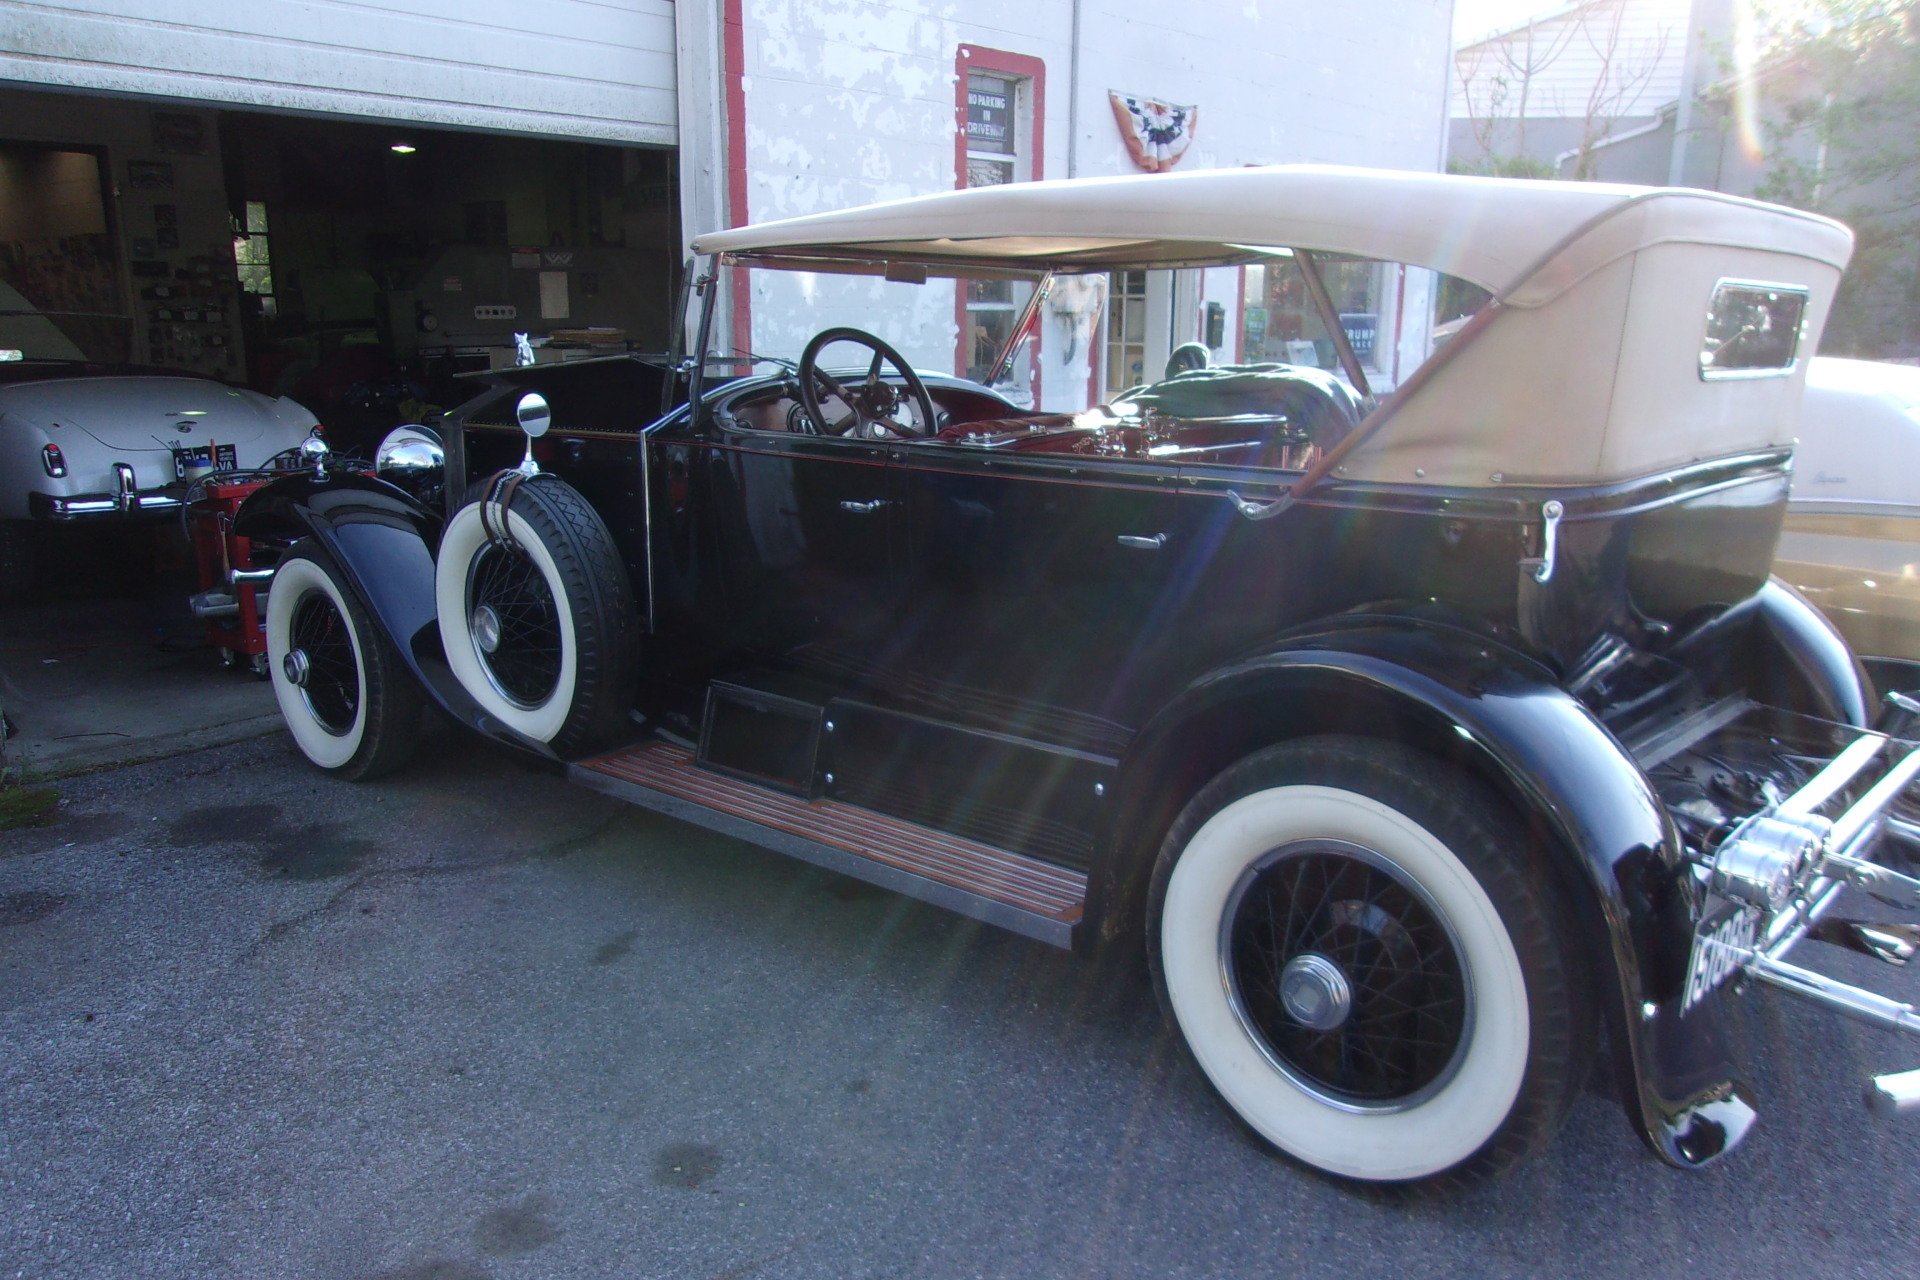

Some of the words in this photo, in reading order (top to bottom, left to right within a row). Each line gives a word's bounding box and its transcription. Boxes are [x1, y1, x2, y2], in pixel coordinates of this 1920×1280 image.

[968, 92, 977, 105] NO
[978, 94, 1005, 109] PARKING
[983, 110, 990, 121] IN
